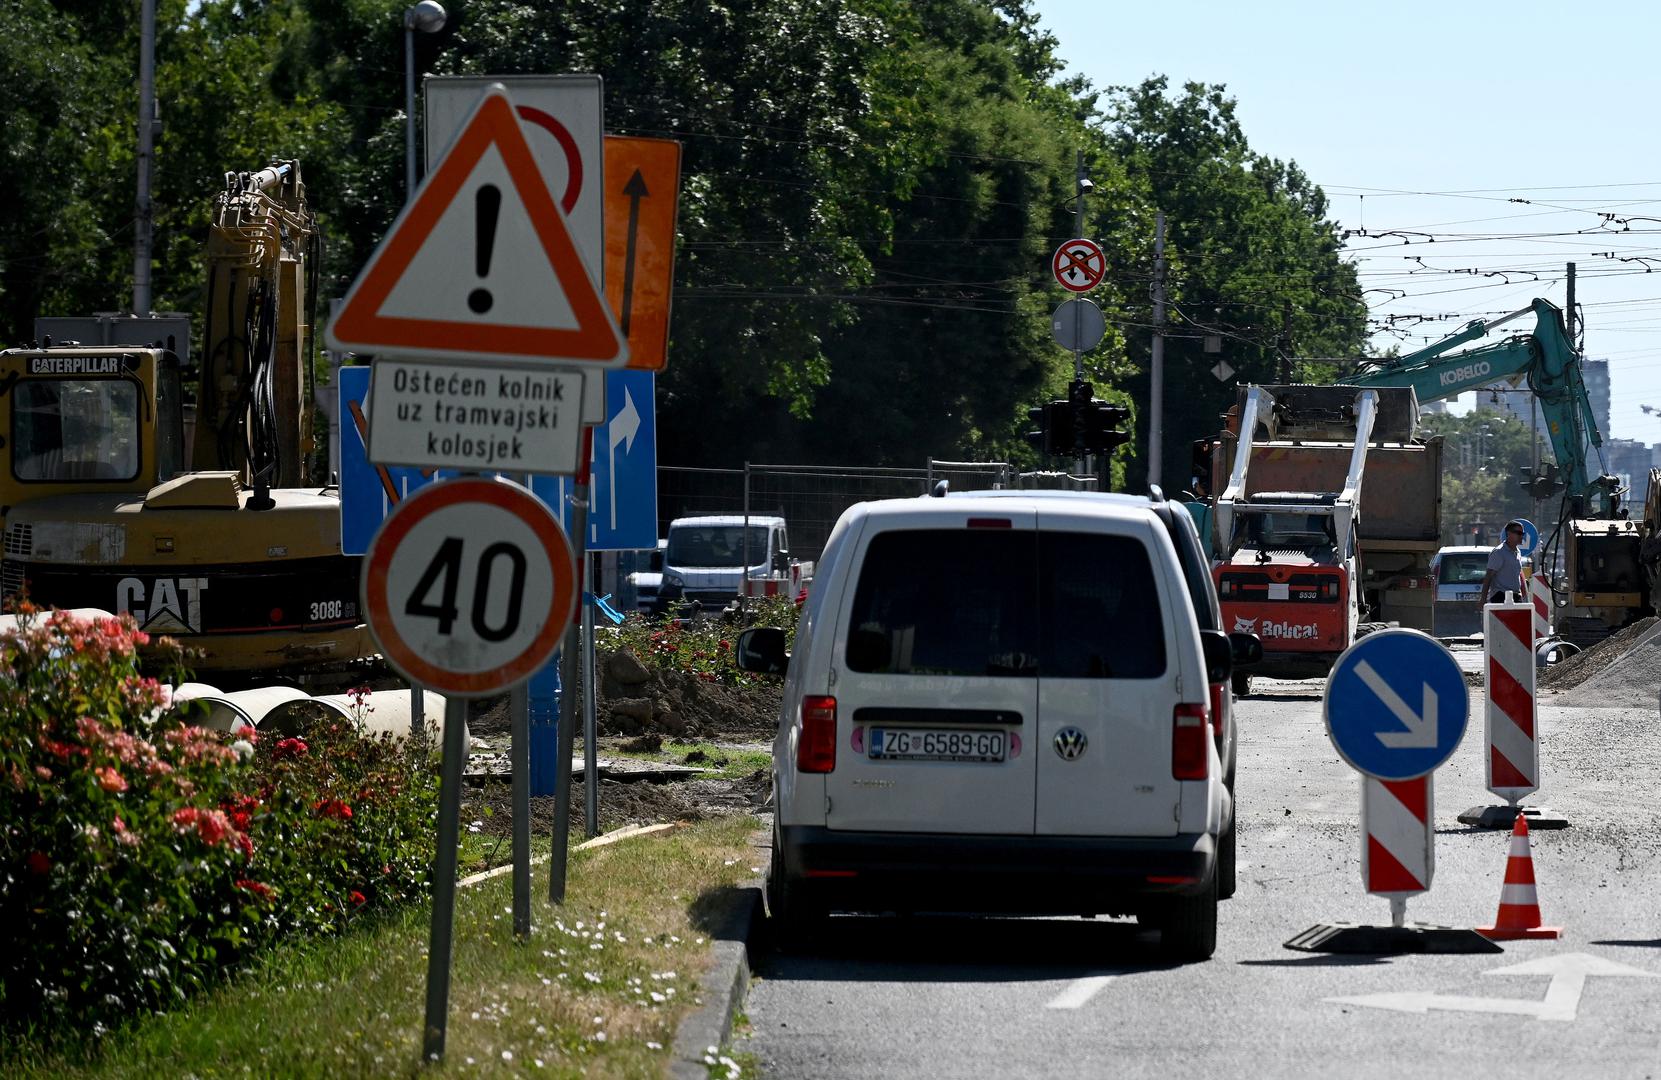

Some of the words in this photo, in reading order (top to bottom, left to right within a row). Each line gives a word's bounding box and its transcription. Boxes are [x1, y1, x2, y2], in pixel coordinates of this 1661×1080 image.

[31, 357, 119, 374] CATERPILLAR
[1439, 361, 1491, 387] KOBELCO
[393, 367, 487, 397] Oštećen
[499, 374, 565, 402] kolnik
[396, 402, 422, 422] uz
[434, 399, 558, 433] tramvajski
[426, 430, 523, 465] kolosjek
[404, 535, 528, 643] 40
[1298, 591, 1318, 600] S530
[117, 577, 209, 633] CAT
[310, 600, 342, 621] 308C
[1262, 620, 1319, 639] Bobcat
[885, 732, 911, 754] ZG
